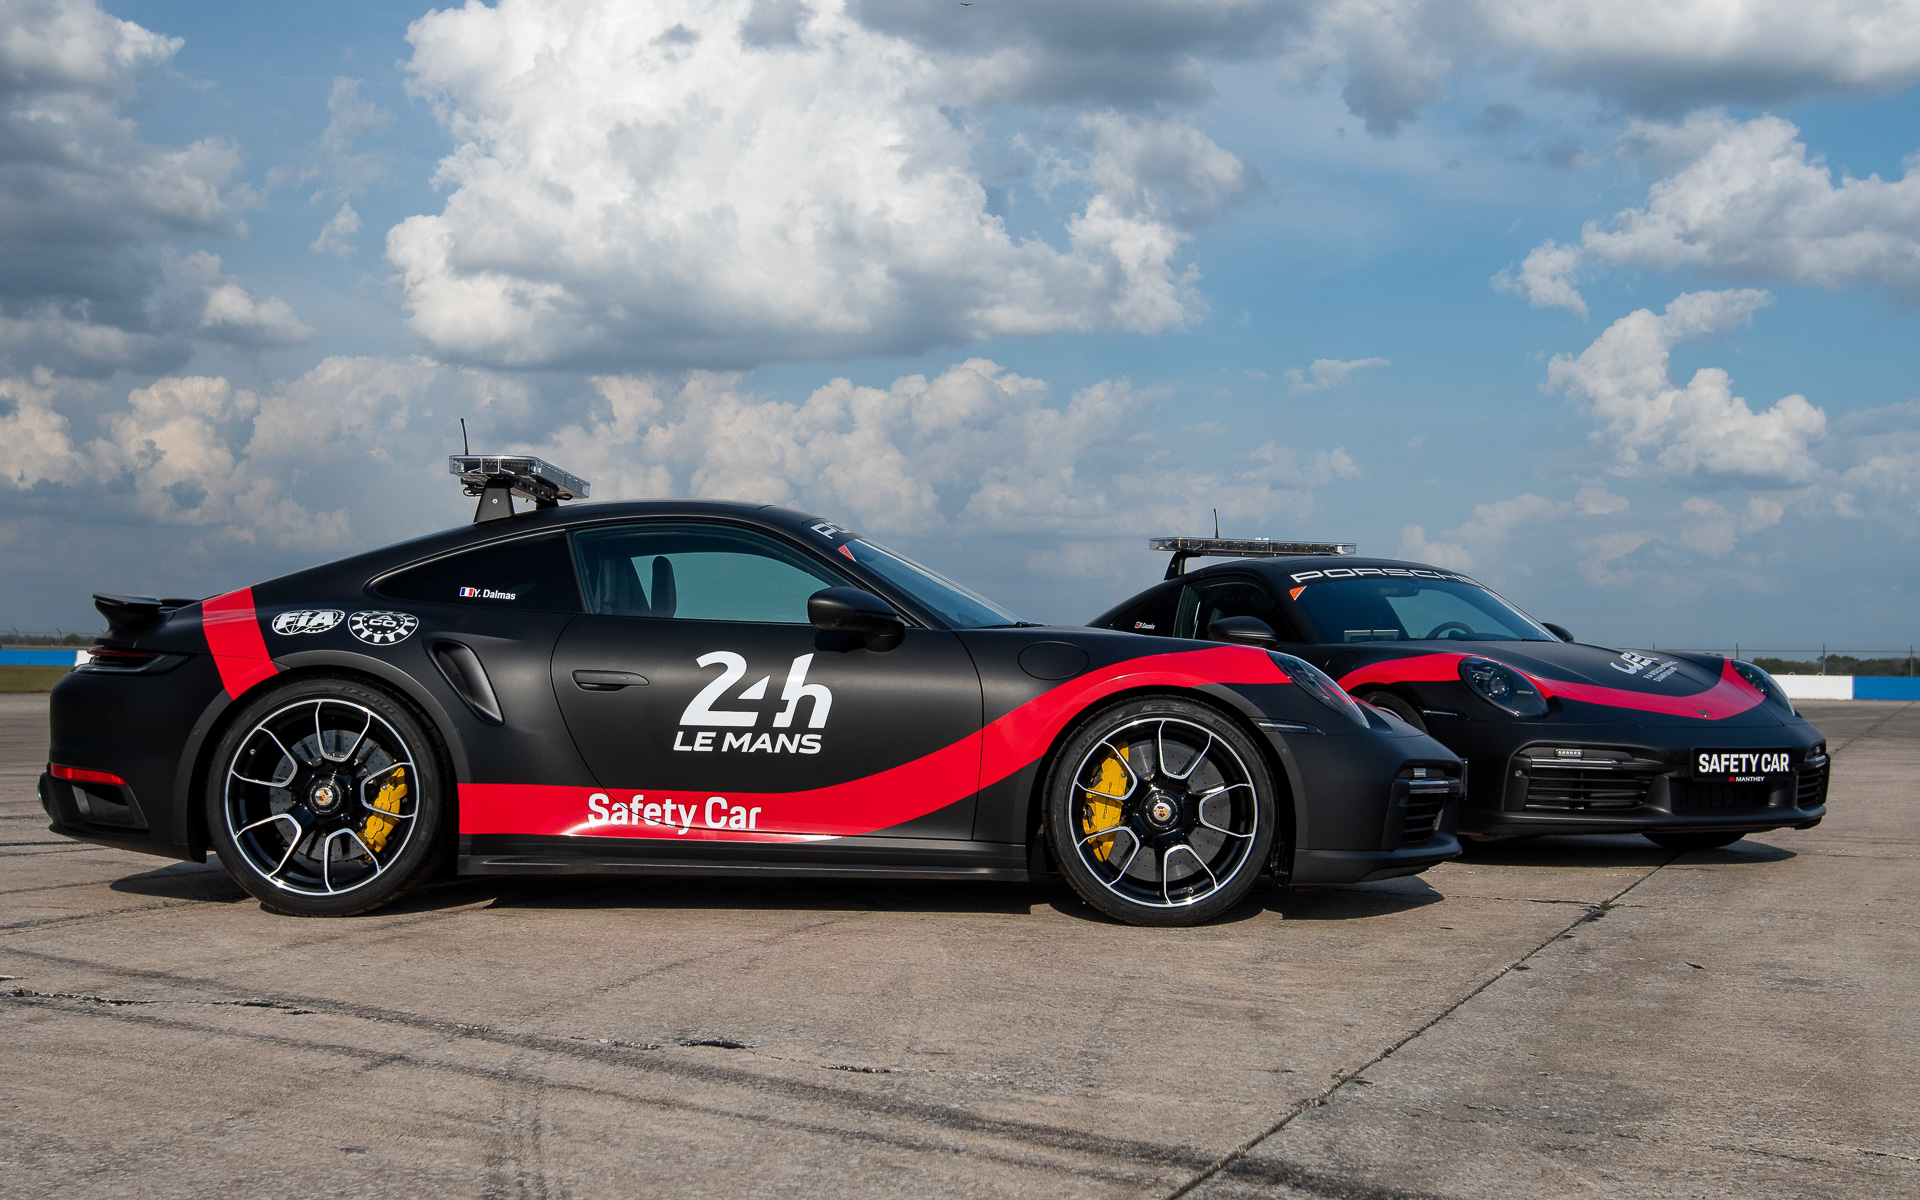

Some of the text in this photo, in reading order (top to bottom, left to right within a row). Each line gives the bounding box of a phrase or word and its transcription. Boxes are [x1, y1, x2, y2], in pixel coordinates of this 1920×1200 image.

[474, 588, 516, 600] Y. Dalmas
[679, 650, 833, 729] 24h
[673, 730, 822, 755] LE MANS
[1698, 753, 1790, 773] SAFETY CAR
[587, 792, 762, 836] Safety Car
